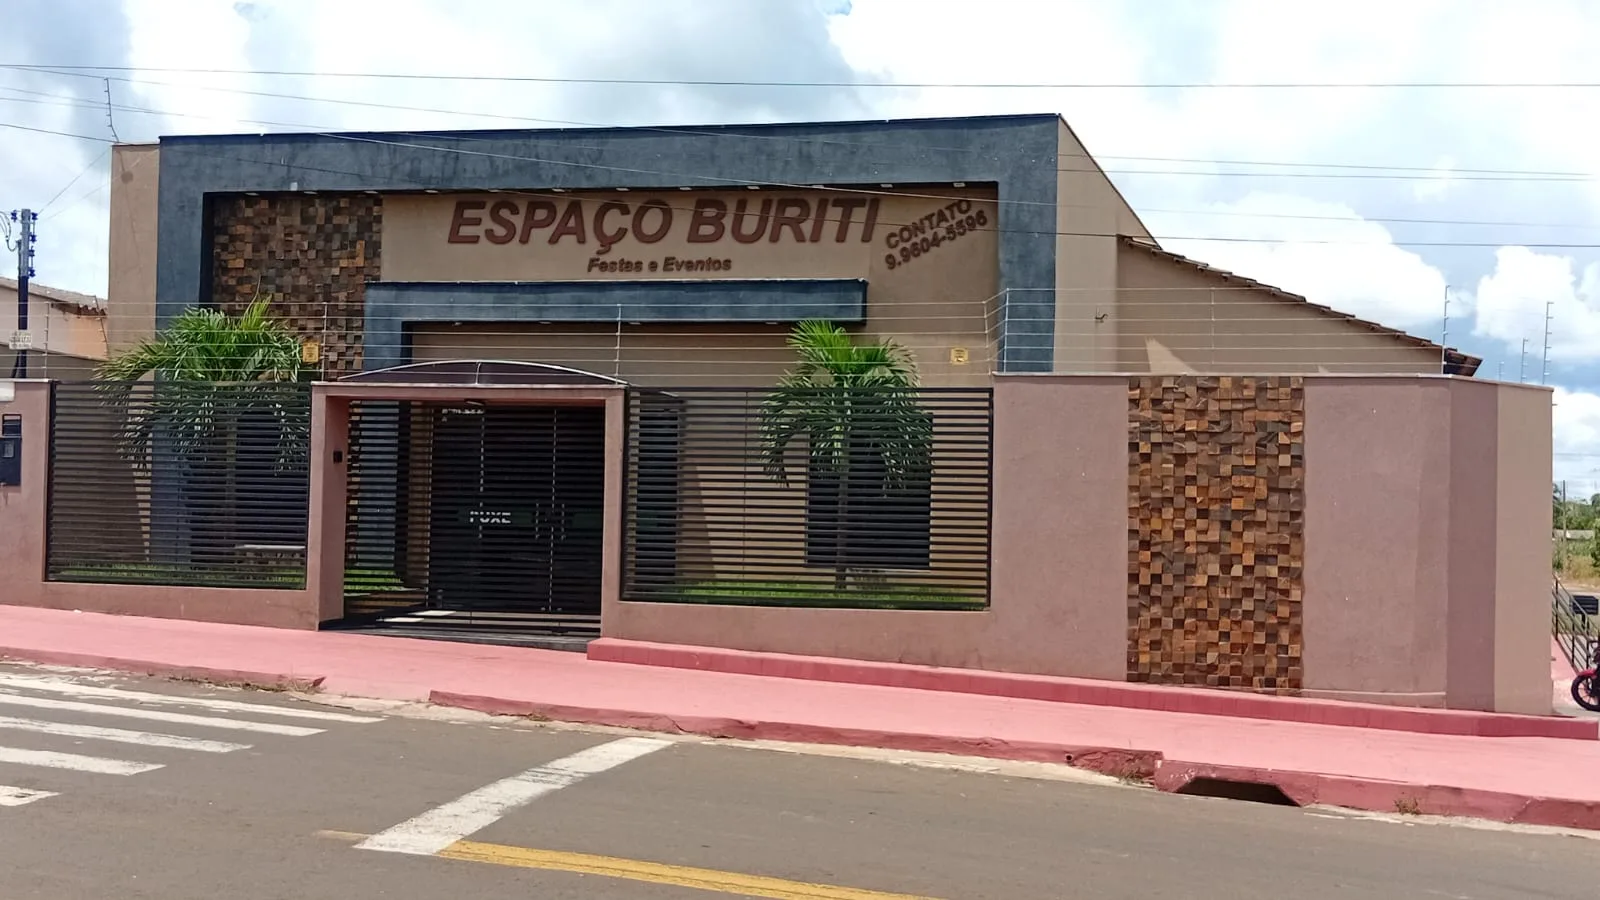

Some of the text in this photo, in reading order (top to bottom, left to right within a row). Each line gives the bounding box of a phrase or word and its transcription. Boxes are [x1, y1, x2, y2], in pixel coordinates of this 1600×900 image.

[447, 196, 881, 255] ESPAÇO BURITI
[885, 199, 972, 249] CONTATO
[587, 256, 732, 273] Festas e Eventos
[469, 510, 512, 524] PUXE
